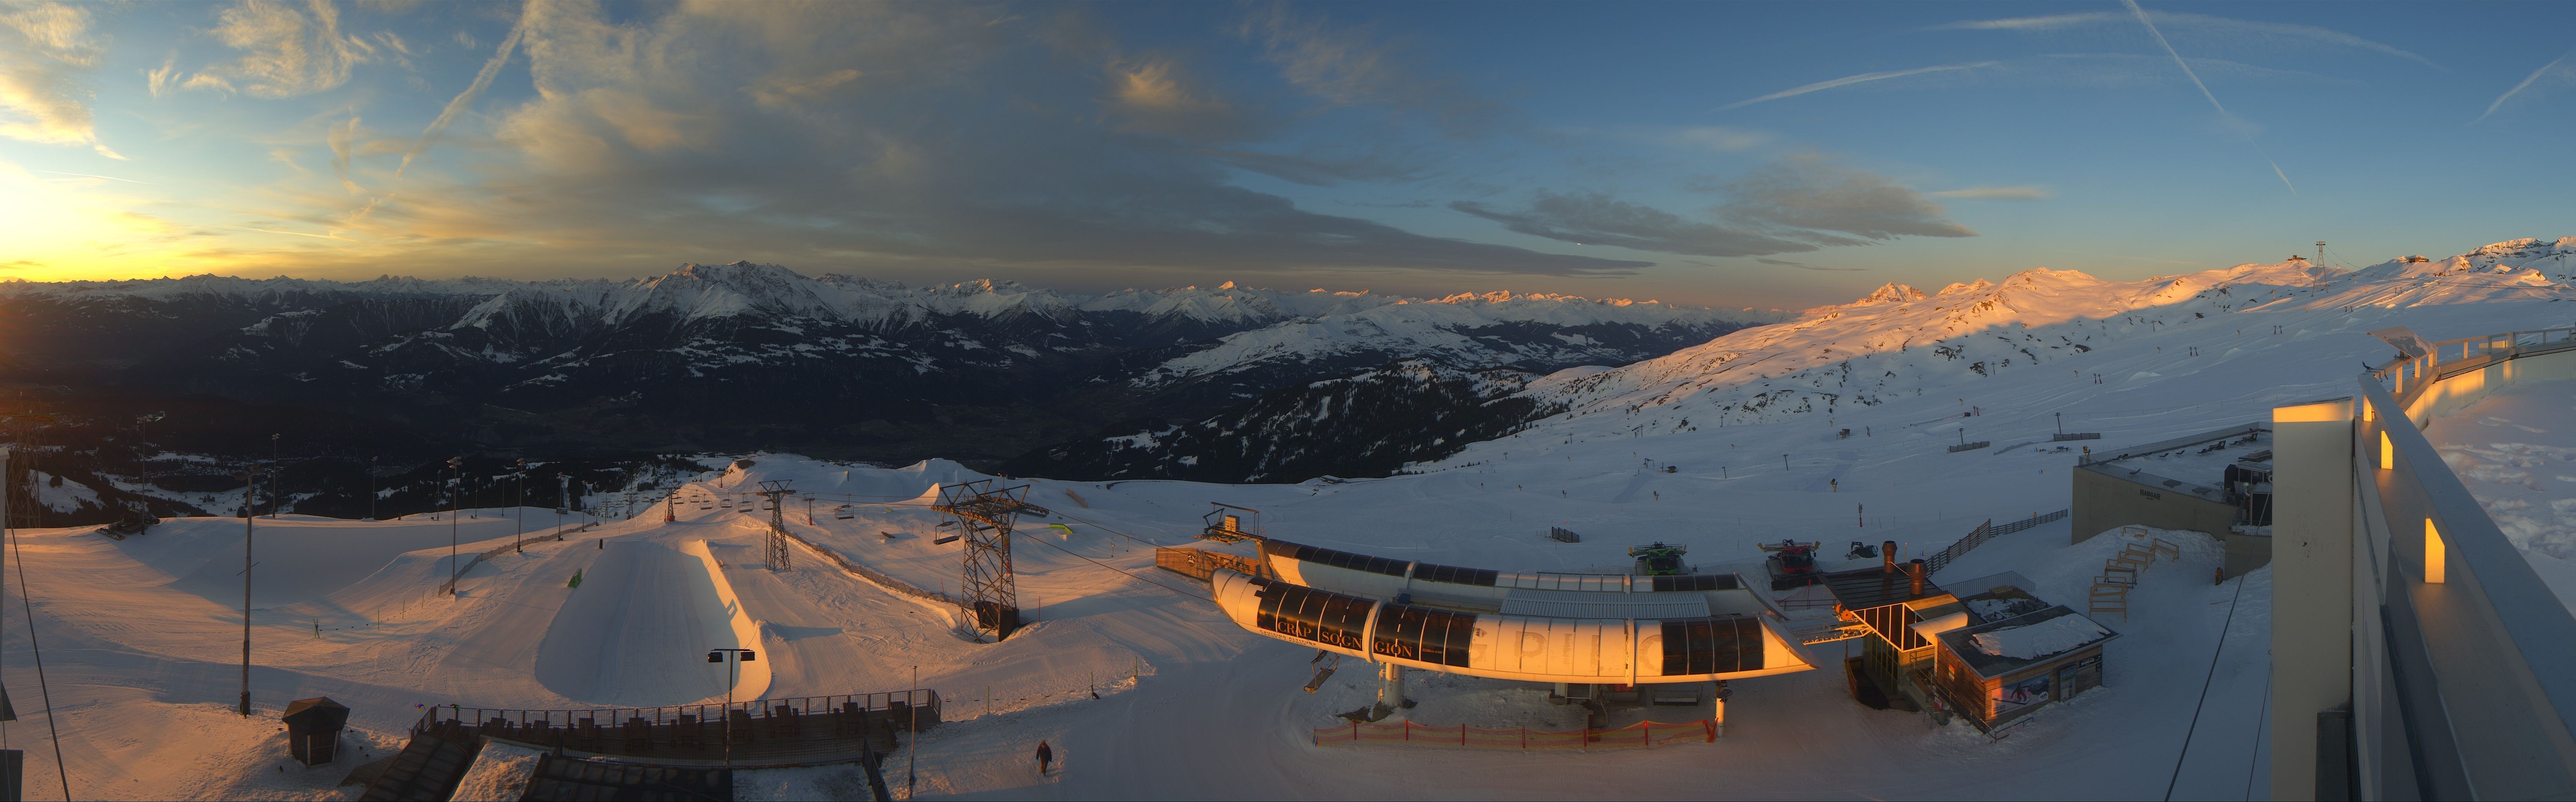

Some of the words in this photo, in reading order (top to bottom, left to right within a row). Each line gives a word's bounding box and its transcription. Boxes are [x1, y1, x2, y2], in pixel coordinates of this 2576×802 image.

[2140, 489, 2161, 500] HANGAR
[1260, 630, 1286, 638] CRUISING
[1289, 637, 1317, 645] ALTITUDE
[1277, 621, 1311, 637] CRAP
[1322, 631, 1362, 649] SOGN
[1375, 641, 1412, 657] GION
